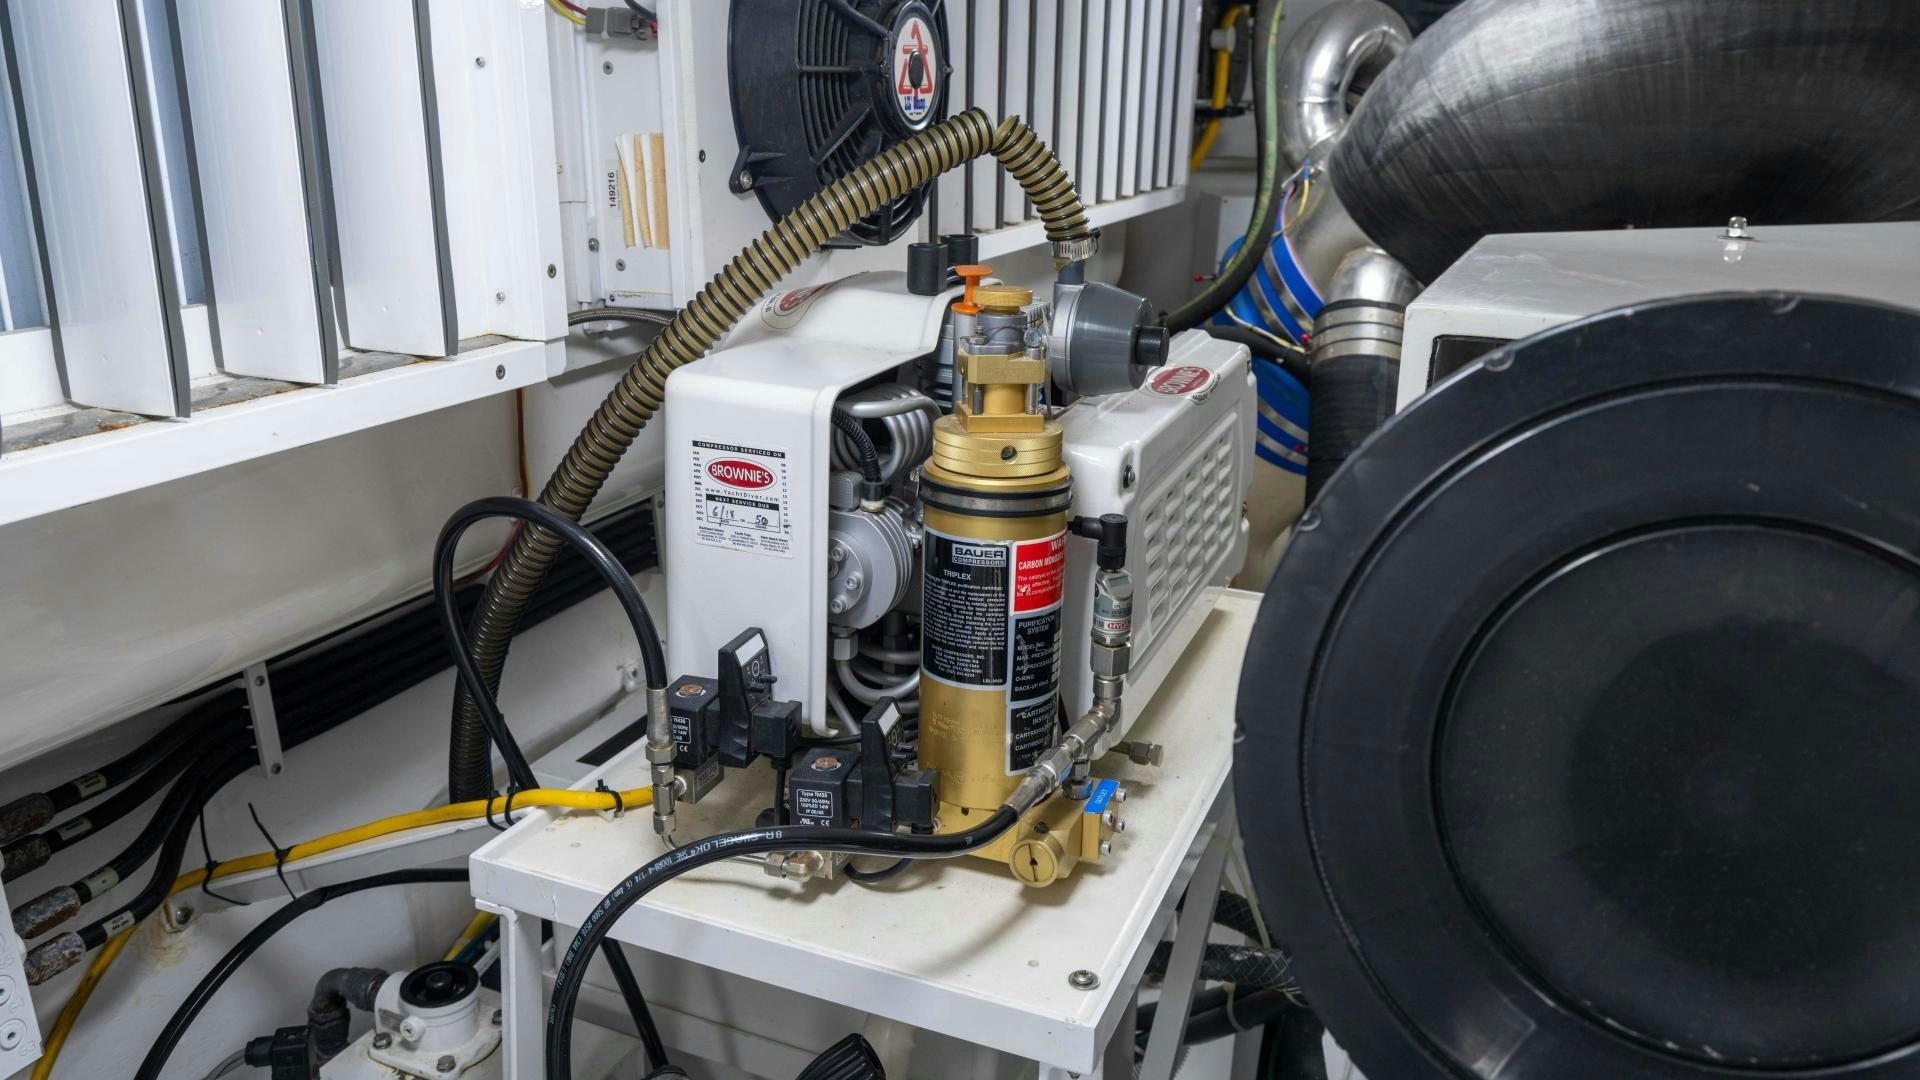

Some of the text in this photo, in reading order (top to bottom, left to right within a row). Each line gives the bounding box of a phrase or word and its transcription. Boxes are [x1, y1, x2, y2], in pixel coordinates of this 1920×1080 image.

[608, 172, 616, 208] 149216
[698, 442, 738, 451] COMPRESSOR
[740, 447, 770, 456] SERVICED
[712, 465, 770, 483] BROWNIE'S
[732, 498, 755, 506] SERVICE
[954, 547, 1004, 558] BAUER
[953, 557, 1005, 566] COMPRESSORS
[1018, 559, 1043, 570] CARBON
[944, 569, 971, 580] TRIPLEX
[1027, 624, 1049, 634] SYSTEM
